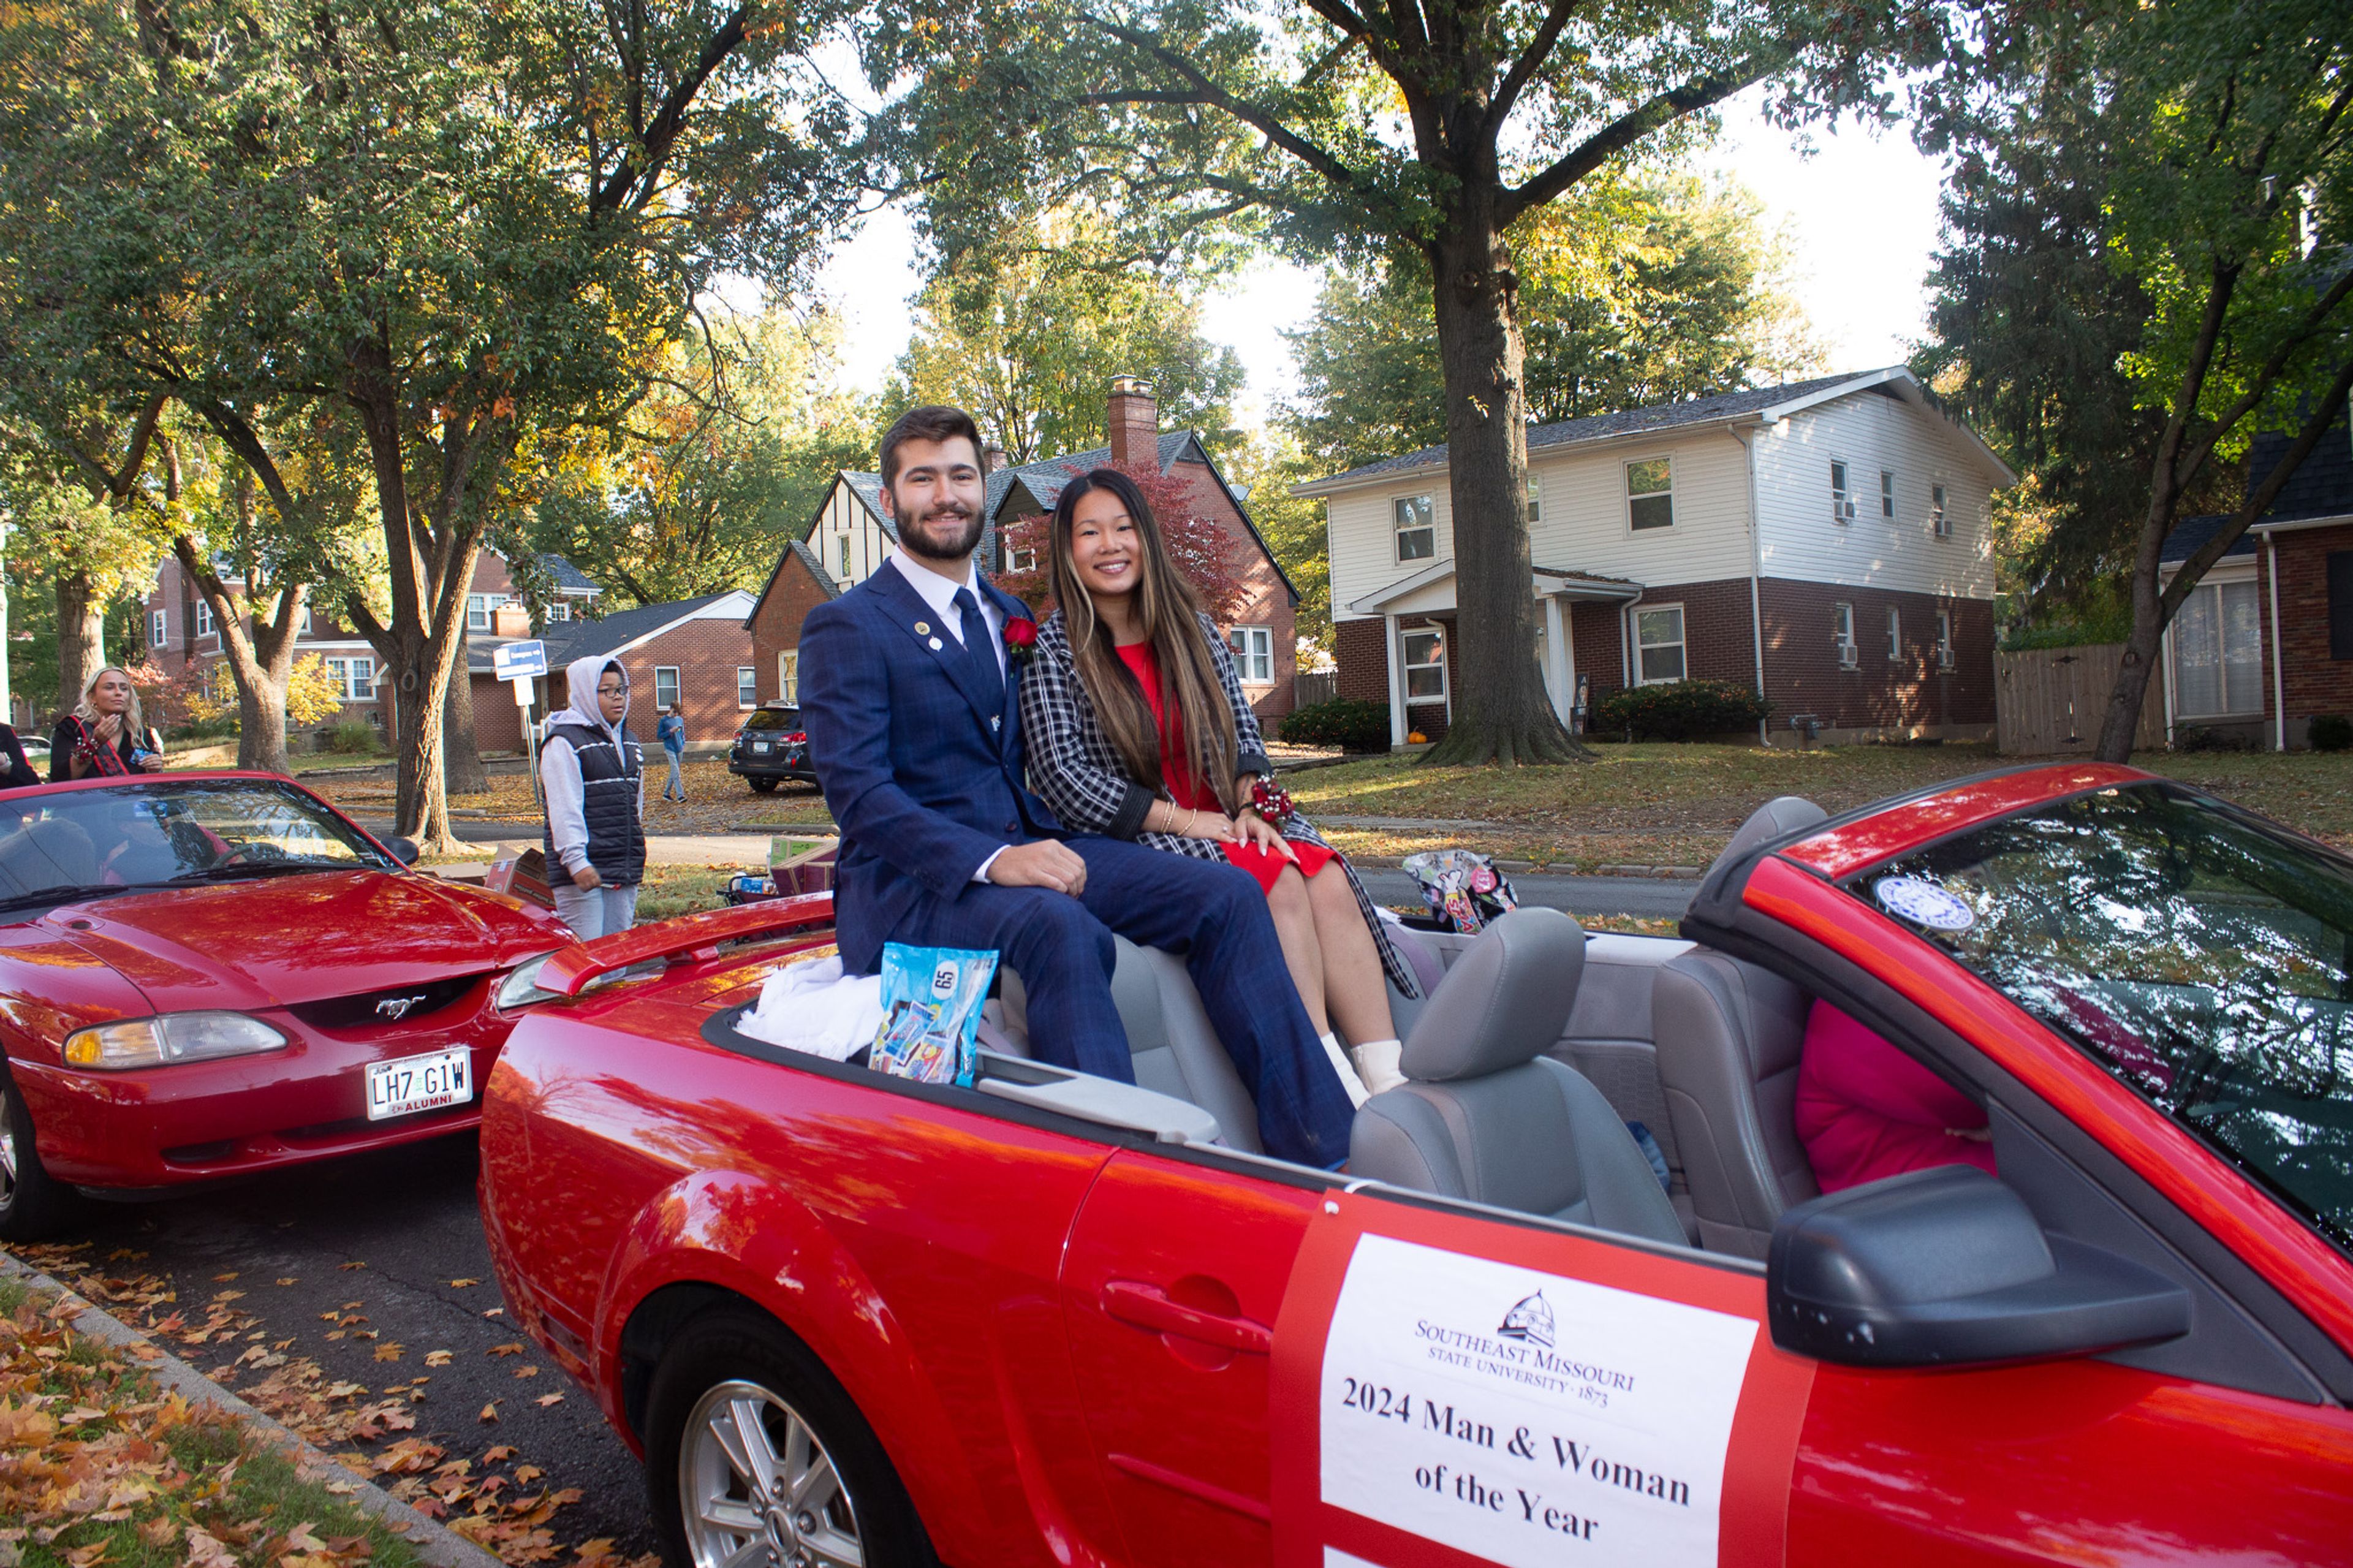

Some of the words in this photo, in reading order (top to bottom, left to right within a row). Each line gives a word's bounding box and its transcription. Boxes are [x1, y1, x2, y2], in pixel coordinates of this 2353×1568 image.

[1476, 869, 1491, 890] 137
[935, 971, 953, 989] 65
[373, 1070, 413, 1105] LH7
[425, 1061, 464, 1094] G1W
[405, 1095, 452, 1112] ALUMNI
[1415, 1320, 1531, 1364] SOUTHEAST
[1534, 1350, 1635, 1392] MISSOURI
[1428, 1347, 1472, 1368] STATE
[1477, 1359, 1569, 1394] UNIVERSITY
[1578, 1387, 1608, 1408] 1873
[1343, 1377, 1411, 1423] 2024
[1423, 1399, 1495, 1449] Man
[1507, 1426, 1536, 1461] &
[1552, 1435, 1691, 1507] Woman
[1415, 1464, 1448, 1494] of
[1455, 1474, 1504, 1512] the
[1517, 1489, 1599, 1542] Year
